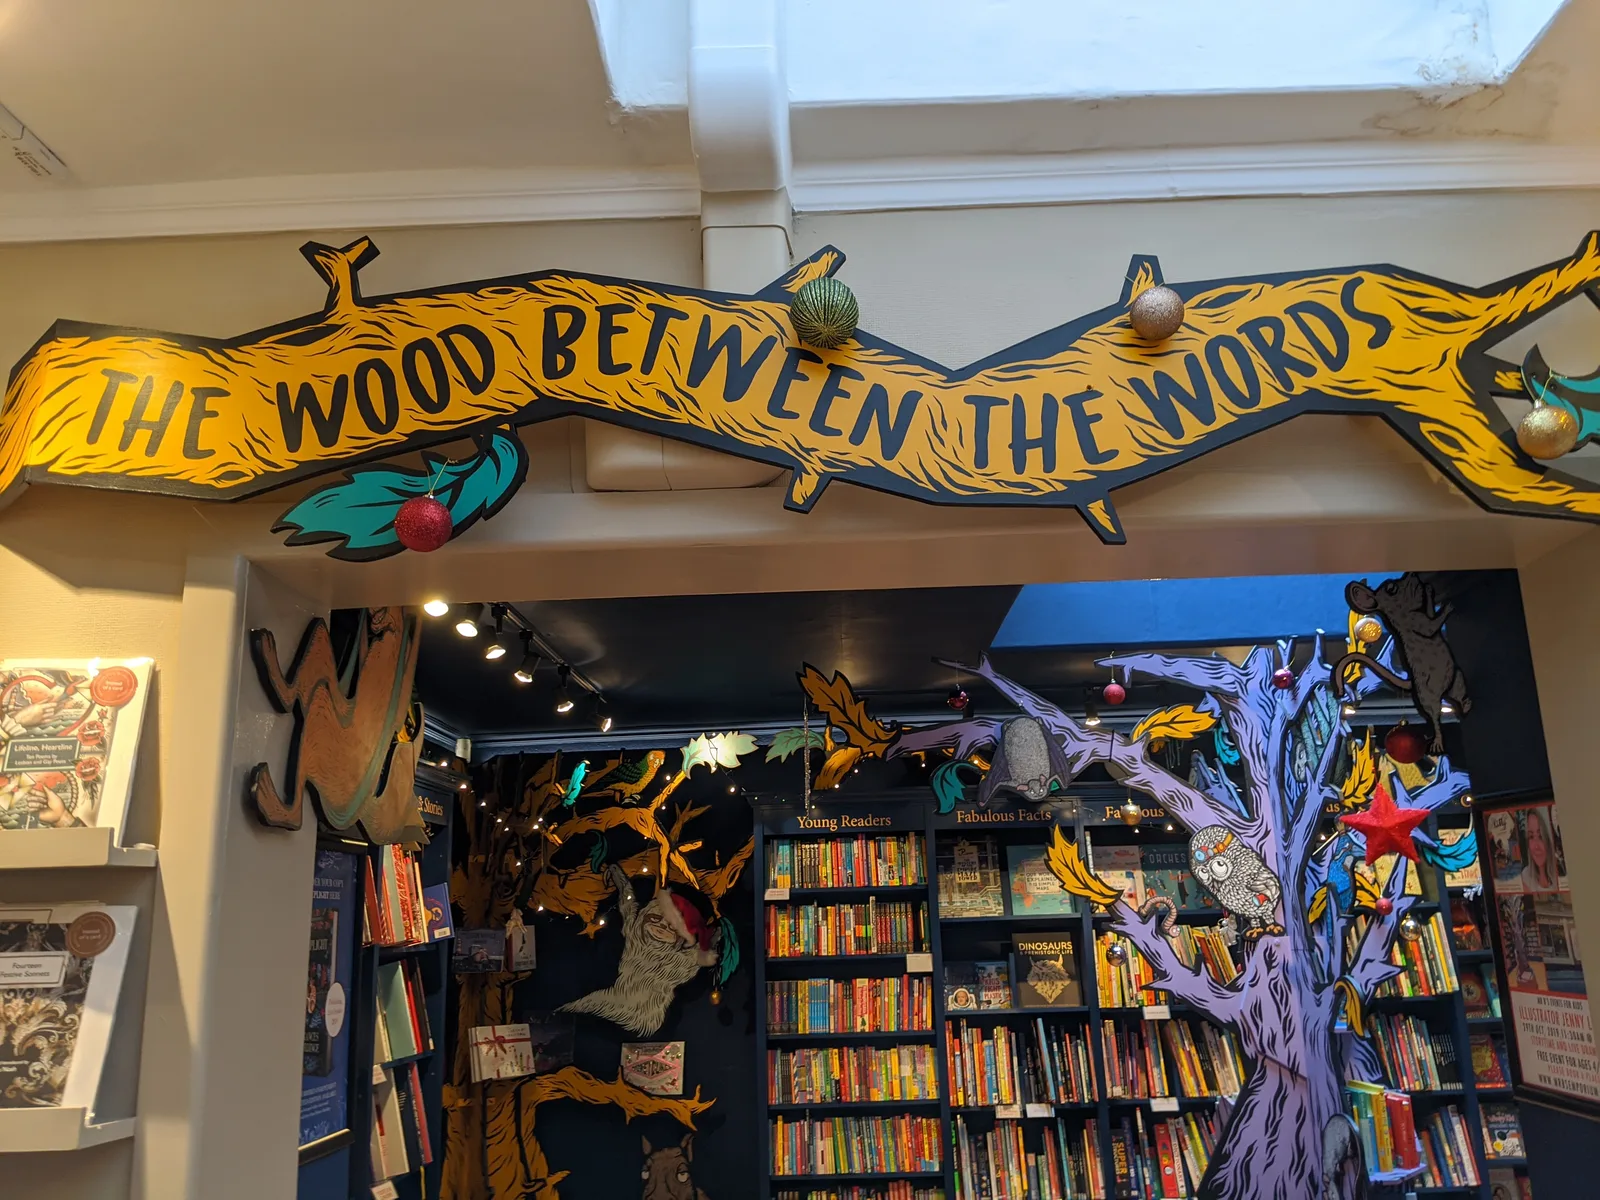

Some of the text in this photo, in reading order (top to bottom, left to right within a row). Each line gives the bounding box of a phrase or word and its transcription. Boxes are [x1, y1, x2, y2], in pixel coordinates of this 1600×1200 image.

[86, 276, 1392, 475] THE WOOD BETWEEN THE WORDS
[956, 808, 1052, 823] Fabulous Facts
[1104, 805, 1165, 819] Faous
[796, 813, 892, 832] Young Readers
[1018, 941, 1073, 951] DINOSAURS
[24, 970, 50, 978] Sonnets
[1519, 1006, 1561, 1026] ILLUSTRATOR
[1562, 1012, 1585, 1030] JENNY
[1536, 1050, 1549, 1062] FREE
[1549, 1052, 1565, 1065] EVENT
[1565, 1056, 1577, 1068] FOR
[1578, 1058, 1592, 1071] AGES
[1117, 1142, 1128, 1174] SUPER
[1172, 1143, 1184, 1182] DICTIONARY
